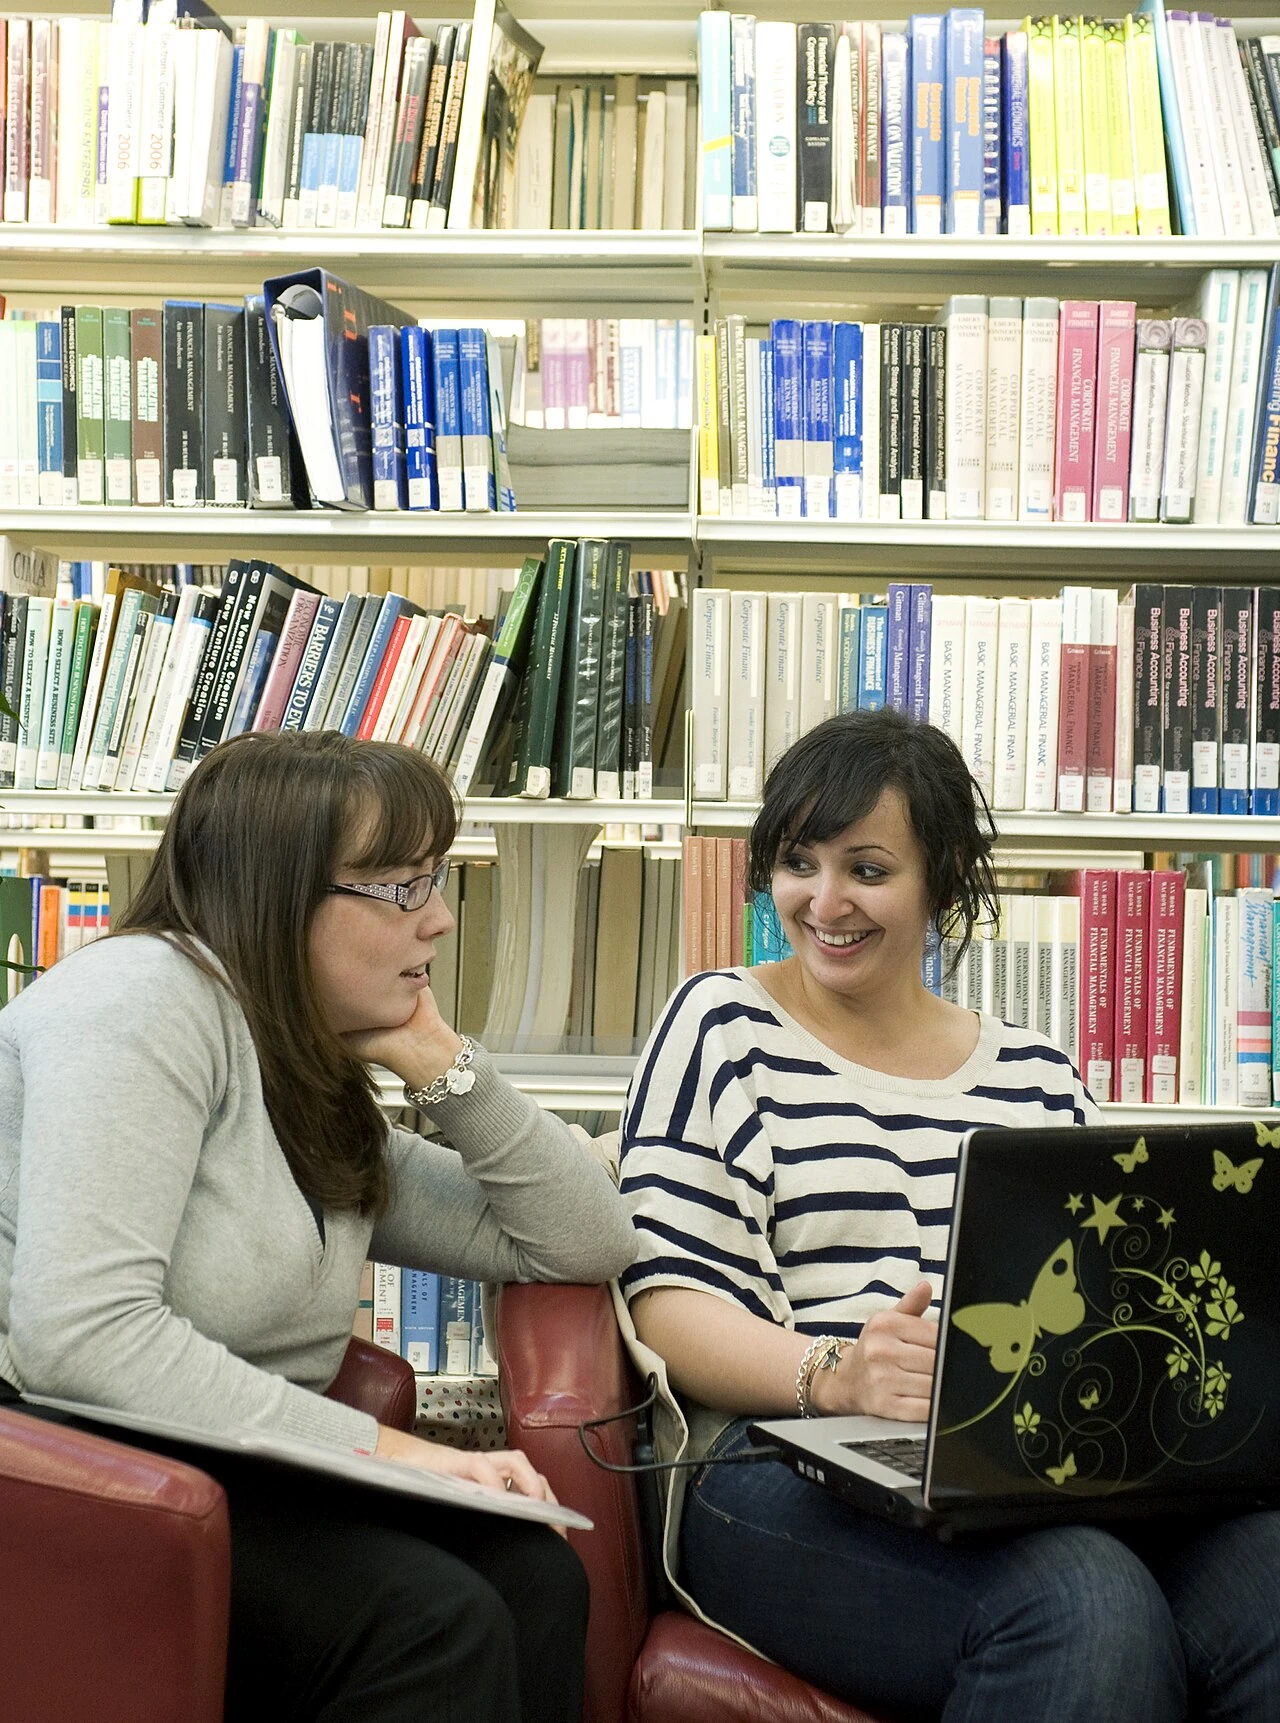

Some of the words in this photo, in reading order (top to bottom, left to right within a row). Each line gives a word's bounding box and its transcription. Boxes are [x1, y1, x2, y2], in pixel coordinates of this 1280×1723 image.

[159, 32, 170, 77] Electronic
[806, 37, 817, 80] Corporate
[818, 37, 828, 74] Financial
[453, 60, 466, 97] EXPERT
[806, 81, 816, 106] Policy
[817, 76, 828, 106] Theory
[867, 50, 877, 111] MANAGEMENT
[887, 61, 901, 124] DAMODARAN
[158, 81, 169, 129] Commerce
[243, 107, 253, 128] Doing
[818, 106, 828, 124] and
[867, 112, 877, 124] OF
[917, 82, 928, 128] Finance
[930, 83, 942, 141] Corporate
[955, 77, 967, 123] Finance
[968, 77, 981, 136] Corporate
[447, 98, 461, 143] SYSTEMS
[887, 125, 901, 139] ON
[1011, 101, 1023, 147] ECONOMICS
[118, 134, 131, 170] 2006
[150, 134, 162, 170] 2006
[240, 129, 251, 157] Business
[867, 125, 877, 162] FINANCE
[240, 169, 248, 181] the
[241, 158, 248, 168] on
[887, 141, 903, 196] VALUATION
[177, 321, 183, 330] An
[217, 324, 223, 333] An
[735, 326, 745, 372] PRACTICAL
[890, 328, 899, 365] Corporate
[937, 331, 945, 367] Corporate
[186, 360, 194, 411] MANAGEMENT
[890, 366, 899, 396] Strategy
[936, 368, 944, 399] Strategy
[1071, 348, 1082, 396] FINANCIAL
[1109, 347, 1121, 394] FINANCIAL
[736, 373, 746, 420] FINANCIAL
[891, 398, 899, 412] and
[955, 363, 963, 444] MANAGEMENT
[964, 372, 973, 433] FINANCIAL
[974, 369, 984, 437] CORPORATE
[1082, 379, 1093, 432] CORPORATE
[1119, 378, 1131, 432] CORPORATE
[1183, 384, 1191, 408] Methods
[890, 414, 899, 446] Financial
[1069, 398, 1080, 464] MANAGEMENT
[1106, 397, 1118, 463] MANAGEMENT
[1180, 416, 1189, 449] Shareholder
[737, 420, 747, 479] MANAGEMENT
[889, 448, 898, 478] Analysis
[936, 449, 944, 480] Analysis
[1178, 466, 1186, 489] Creation
[12, 552, 46, 587] CIMA
[516, 565, 537, 600] ACCA
[221, 594, 235, 620] New
[293, 599, 314, 649] ECONOMIC
[324, 605, 335, 613] Yip
[703, 598, 714, 642] Corporate
[740, 600, 751, 643] Corporate
[876, 616, 884, 632] The
[894, 591, 904, 621] Gitman
[916, 592, 926, 623] Gitman
[79, 636, 85, 644] TO
[208, 624, 227, 668] Venture
[277, 597, 305, 669] ORGANIZATION
[866, 616, 876, 654] BUSINESS
[1135, 627, 1151, 642] &
[1150, 608, 1161, 650] Business
[1179, 608, 1190, 651] Business
[1207, 609, 1218, 652] Business
[1237, 610, 1249, 653] Business
[5, 637, 17, 686] INDUSTRIAL
[56, 647, 62, 657] TO
[75, 644, 84, 670] CHOOSE
[300, 624, 330, 687] BARRIERS
[704, 644, 714, 679] Finance
[741, 645, 750, 680] Finance
[943, 640, 952, 666] BASIC
[976, 642, 986, 667] BASIC
[1009, 642, 1018, 667] BASIC
[1040, 642, 1050, 667] BASIC
[1135, 641, 1146, 678] Finance
[1164, 642, 1174, 679] Finance
[1192, 643, 1202, 681] Finance
[1224, 644, 1234, 681] Finance
[53, 658, 61, 686] SELECT
[70, 672, 80, 702] BUSINESS
[865, 656, 875, 690] FINANCE
[876, 682, 882, 690] of
[892, 652, 903, 697] Managerial
[914, 653, 924, 697] Managerial
[1066, 664, 1076, 718] MANAGERIAL
[1148, 652, 1160, 706] Accounting
[1177, 653, 1189, 707] Accounting
[1205, 653, 1217, 708] Accounting
[1235, 654, 1248, 709] Accounting
[49, 693, 58, 728] BUSINESS
[193, 672, 213, 721] Creation
[293, 689, 309, 707] TO
[942, 670, 951, 729] MANAGERIAL
[975, 670, 985, 729] MANAGERIAL
[1007, 672, 1017, 731] MANAGERIAL
[1038, 671, 1049, 731] MANAGERIAL
[48, 729, 56, 745] SITE
[66, 702, 76, 736] PREMISES
[1065, 720, 1075, 755] FINANCE
[1037, 734, 1046, 767] FINANC
[1090, 927, 1098, 973] FINANCIAL
[1124, 928, 1133, 974] FINANCIAL
[1156, 928, 1166, 974] FINANCIAL
[1243, 899, 1257, 989] Management
[1256, 904, 1271, 963] Financial
[1021, 947, 1029, 1005] INTERNATIONAL
[1044, 948, 1052, 1006] INTERNATIONAL
[1099, 927, 1109, 994] FUNDAMENTALS
[1134, 928, 1143, 995] FUNDAMENTALS
[1166, 928, 1176, 995] FUNDAMENTALS
[1088, 975, 1098, 1034] MANAGEMENT
[1099, 996, 1107, 1008] OF
[1123, 977, 1132, 1036] MANAGEMENT
[1134, 998, 1142, 1010] OF
[1154, 977, 1164, 1036] MANAGEMENT
[1166, 998, 1174, 1010] OF
[388, 1274, 394, 1287] OF
[422, 1292, 427, 1301] OF
